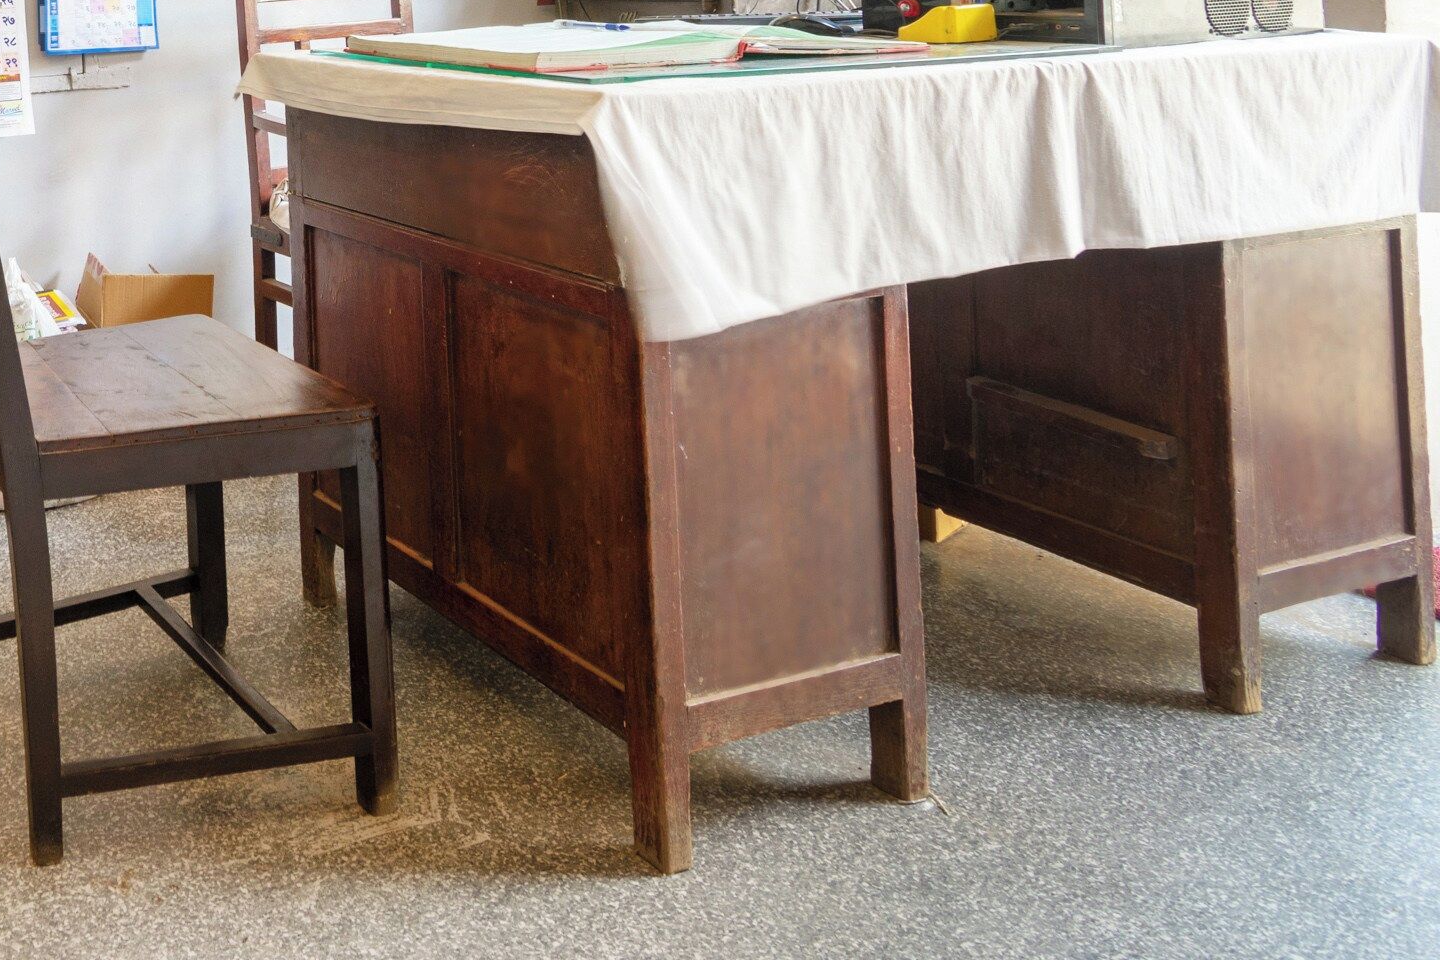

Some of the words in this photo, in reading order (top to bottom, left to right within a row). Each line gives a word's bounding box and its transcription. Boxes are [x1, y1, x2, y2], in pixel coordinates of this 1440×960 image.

[2, 16, 15, 26] २७
[4, 37, 17, 47] २८
[5, 58, 18, 68] २९
